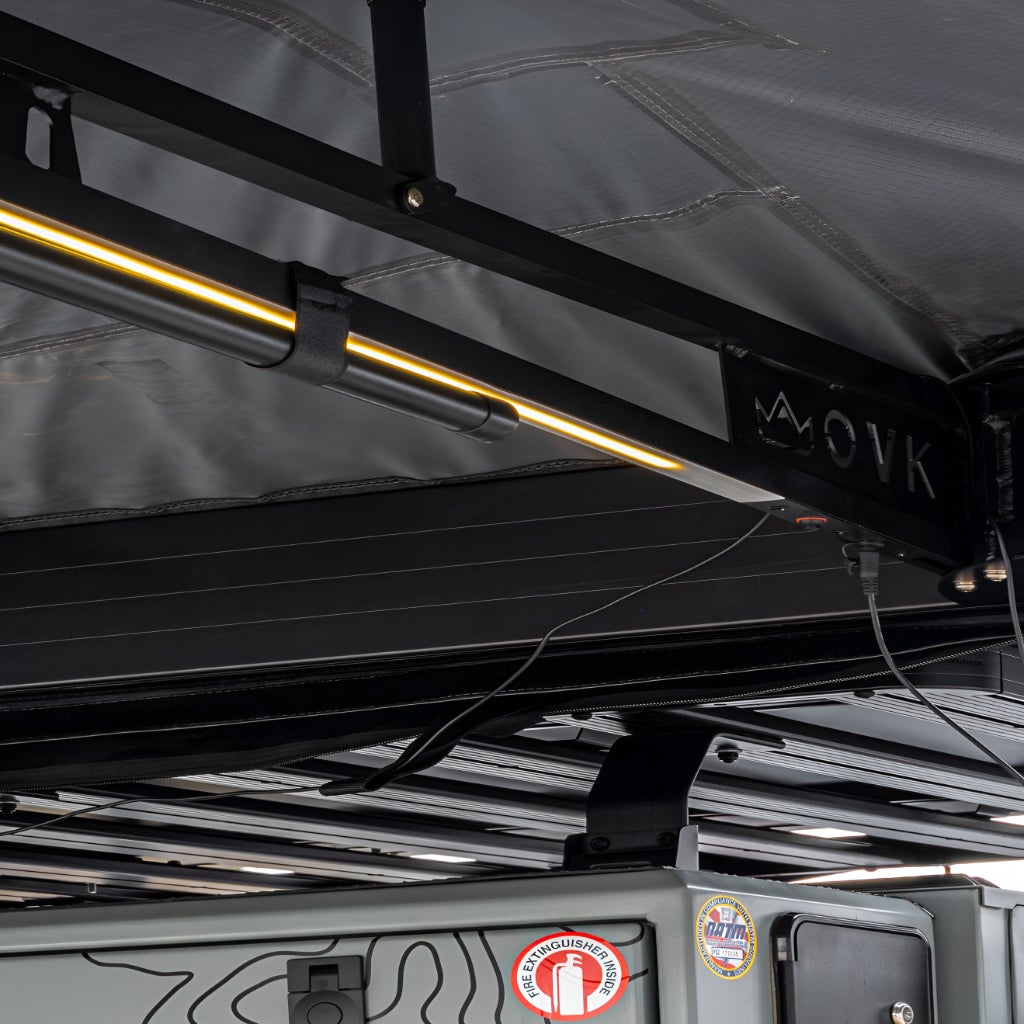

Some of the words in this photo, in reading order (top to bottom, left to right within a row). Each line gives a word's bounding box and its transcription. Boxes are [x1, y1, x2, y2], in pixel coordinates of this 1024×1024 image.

[824, 409, 936, 498] OVK
[523, 939, 609, 972] EXTINGUISHER
[521, 974, 540, 999] FIRE
[599, 959, 617, 996] INSIDE
